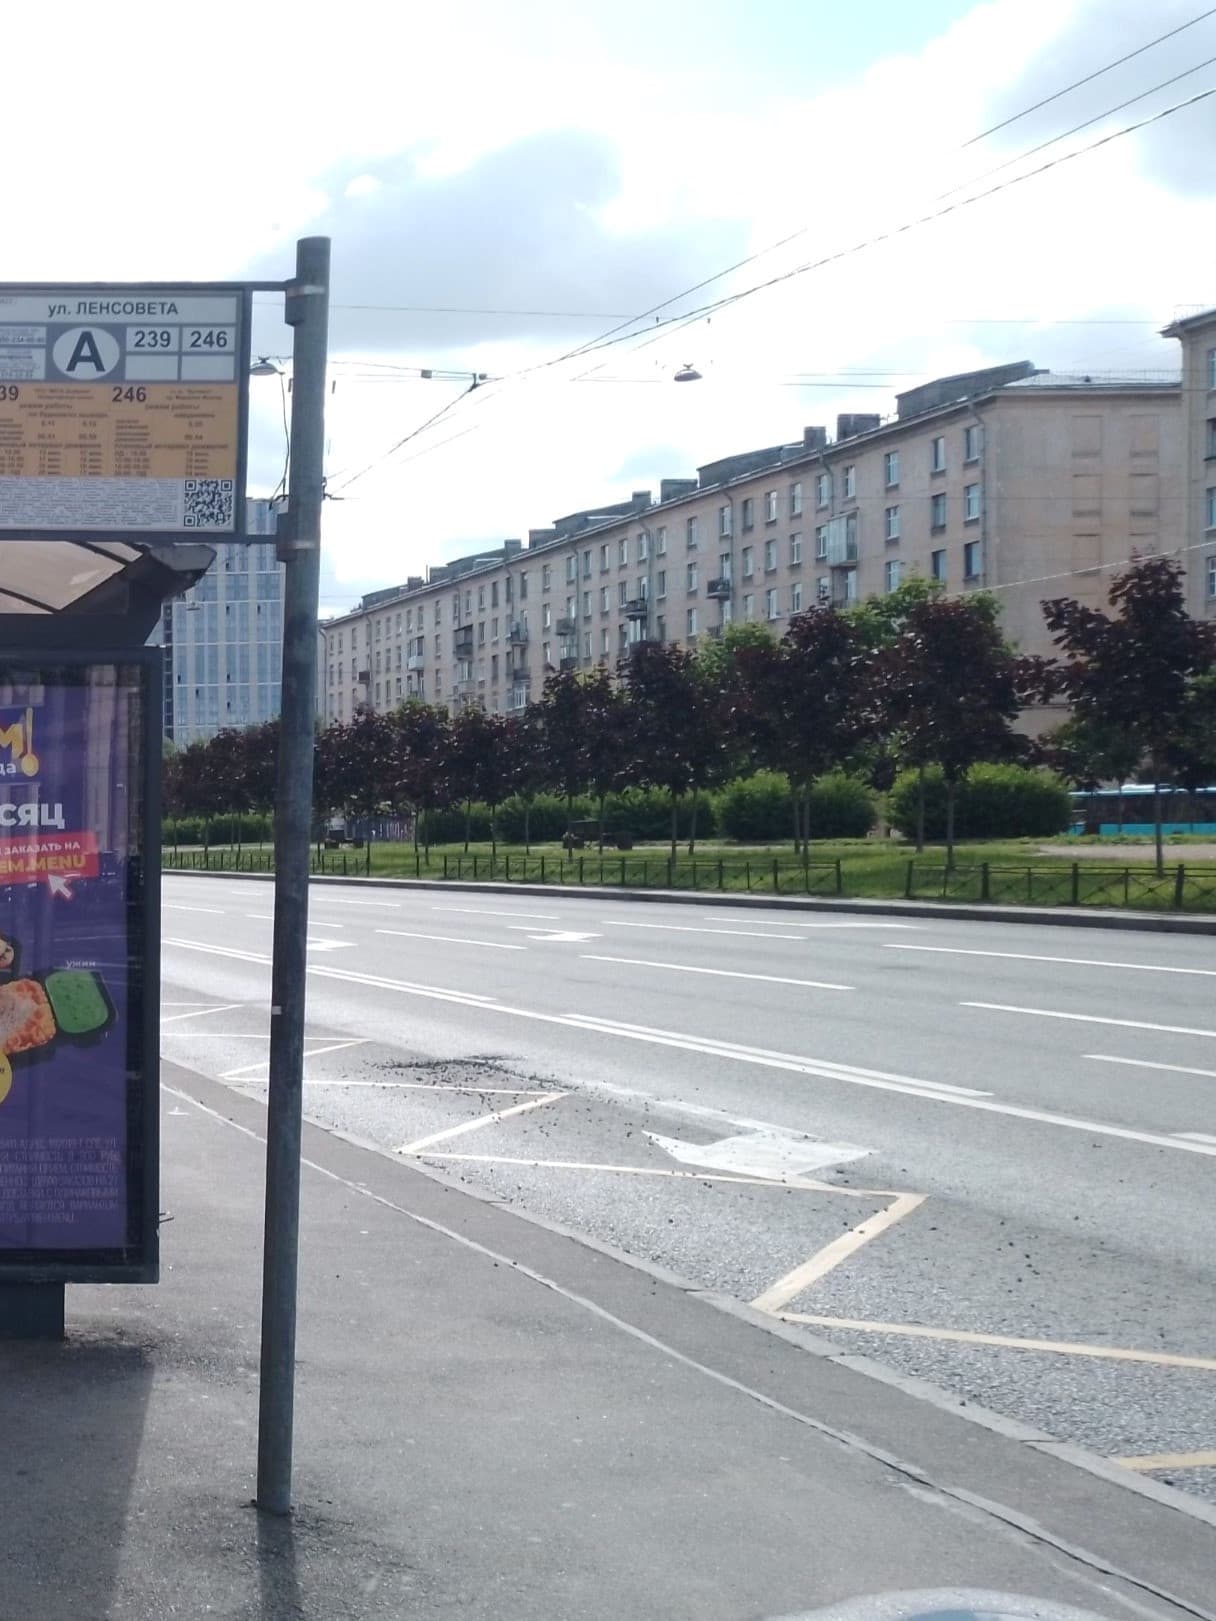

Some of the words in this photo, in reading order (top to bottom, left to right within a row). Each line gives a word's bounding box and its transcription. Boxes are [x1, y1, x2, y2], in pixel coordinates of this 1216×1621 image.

[48, 304, 71, 318] ул.
[75, 302, 179, 316] ЛЕНСОВЕТА
[134, 330, 171, 348] 239
[190, 330, 228, 348] 246
[66, 330, 106, 372] А
[112, 386, 147, 402] 246
[4, 842, 63, 856] ЗАКАЗАТЬ
[65, 841, 81, 851] НА
